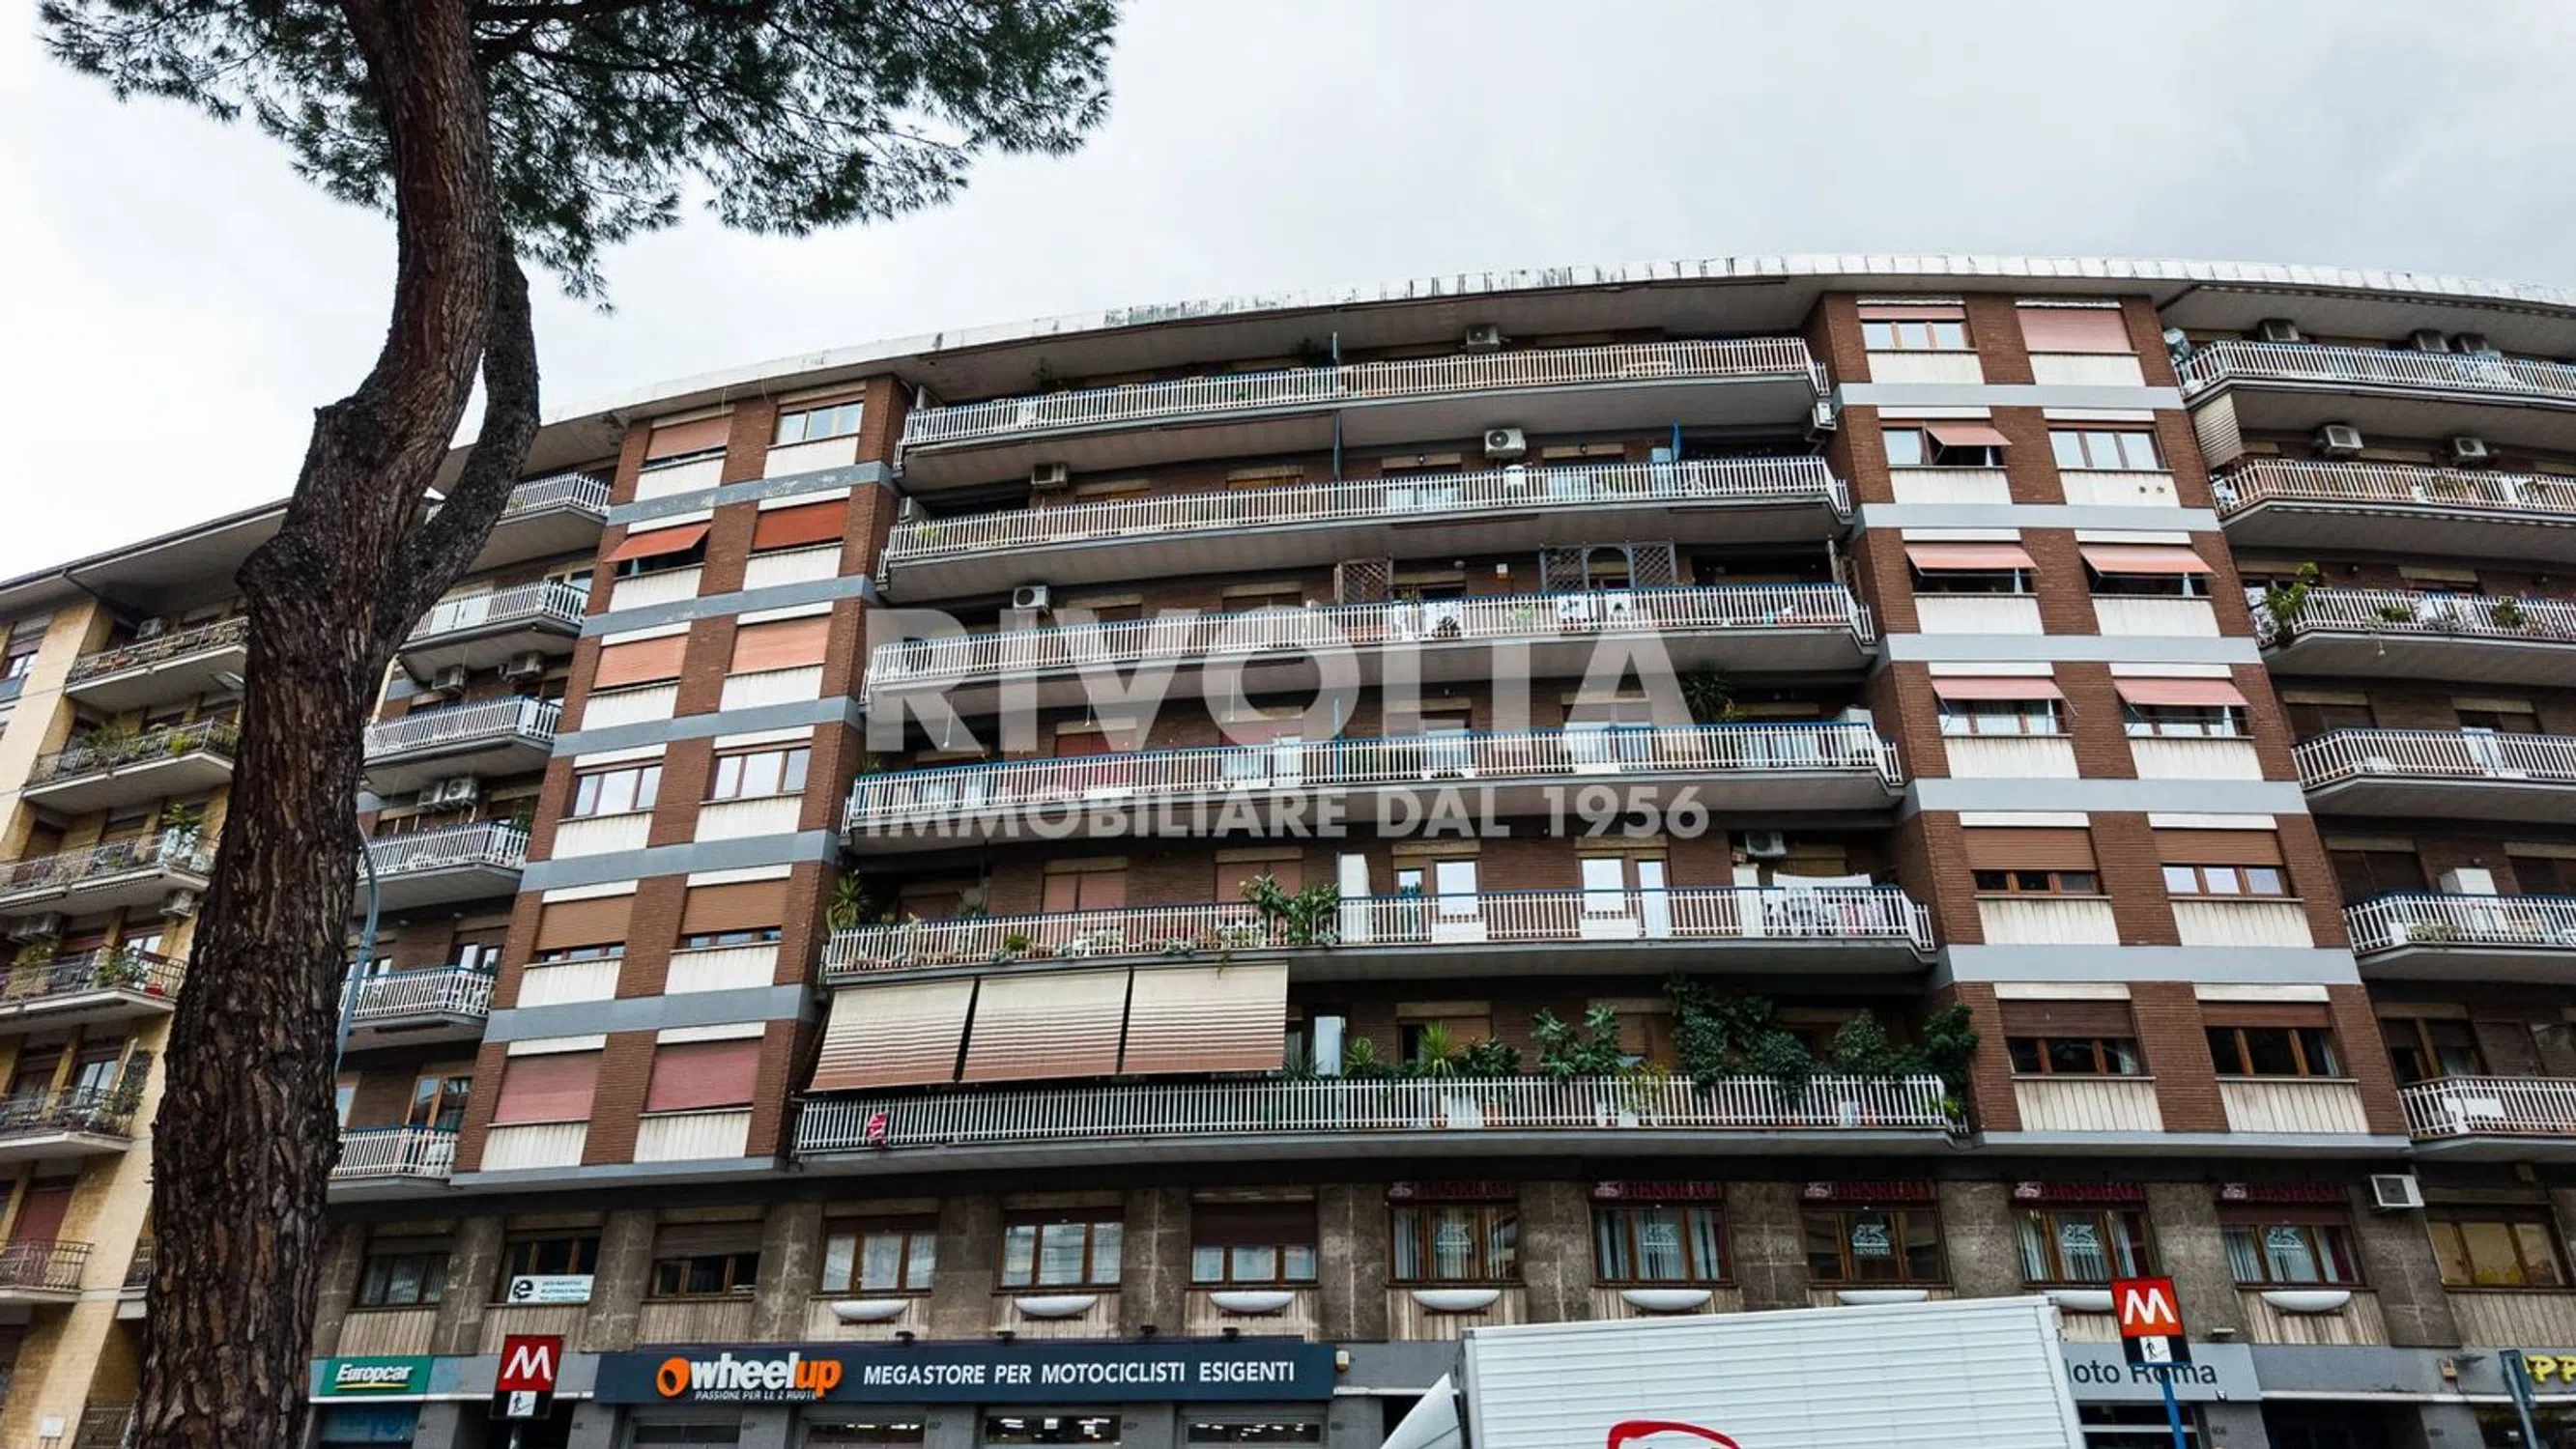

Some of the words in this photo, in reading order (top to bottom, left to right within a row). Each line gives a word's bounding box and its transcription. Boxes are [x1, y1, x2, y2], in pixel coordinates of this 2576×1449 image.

[2124, 1288, 2176, 1324] M
[335, 1363, 414, 1384] Europcar
[503, 1346, 552, 1380] M
[863, 1364, 986, 1385] MEGASTORE
[994, 1364, 1032, 1384] PER
[1041, 1361, 1186, 1384] MOTOCICLISTI
[1198, 1361, 1296, 1382] ESIGENTI
[695, 1389, 740, 1401] PASSIONE
[742, 1389, 761, 1401] PER
[763, 1389, 775, 1401] LE
